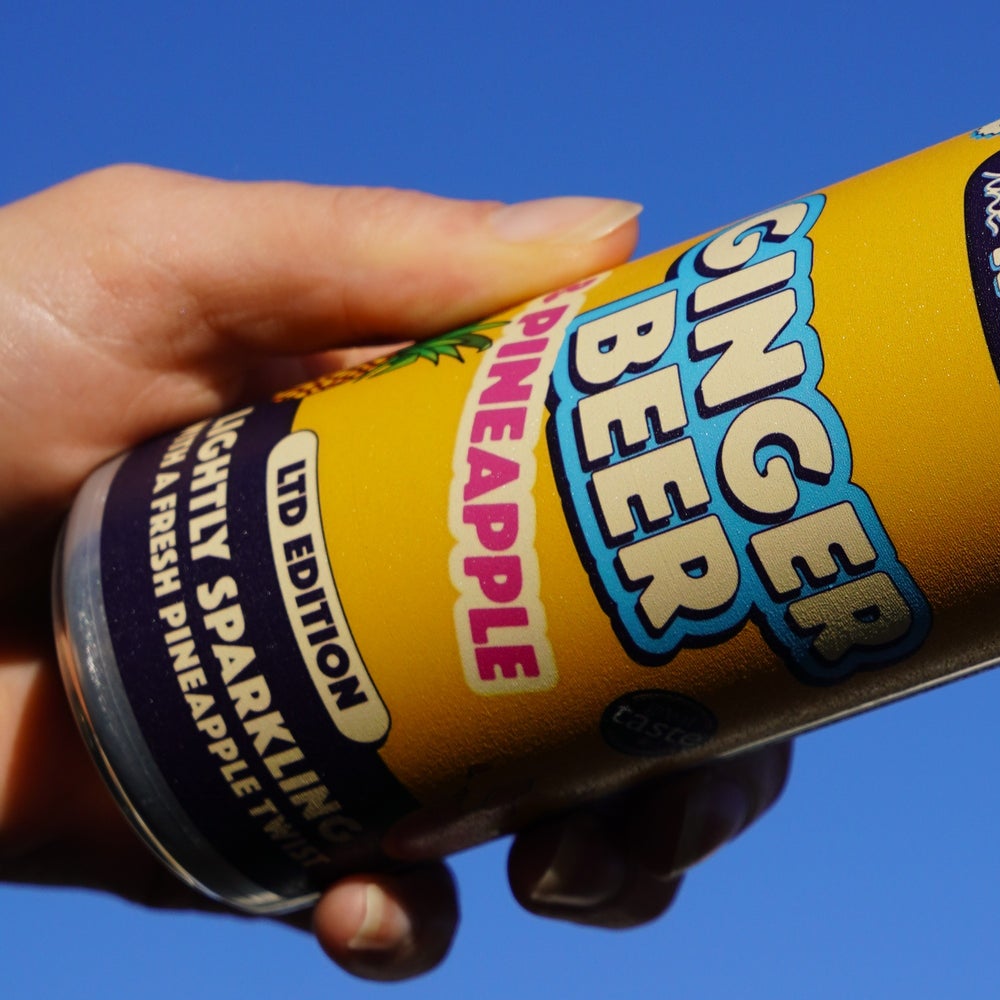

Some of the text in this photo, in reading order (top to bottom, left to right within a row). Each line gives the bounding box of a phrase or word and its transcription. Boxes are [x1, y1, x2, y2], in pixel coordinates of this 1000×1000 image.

[148, 498, 182, 598] FRESH
[151, 472, 182, 496] A
[462, 303, 569, 682] PINEAPPLE
[573, 289, 742, 631] BEER
[687, 201, 912, 664] GINGER
[158, 601, 262, 800] PINEAPPLE
[188, 405, 363, 843] LIGHTLY SPARKLING
[276, 459, 369, 712] LTD EDITION
